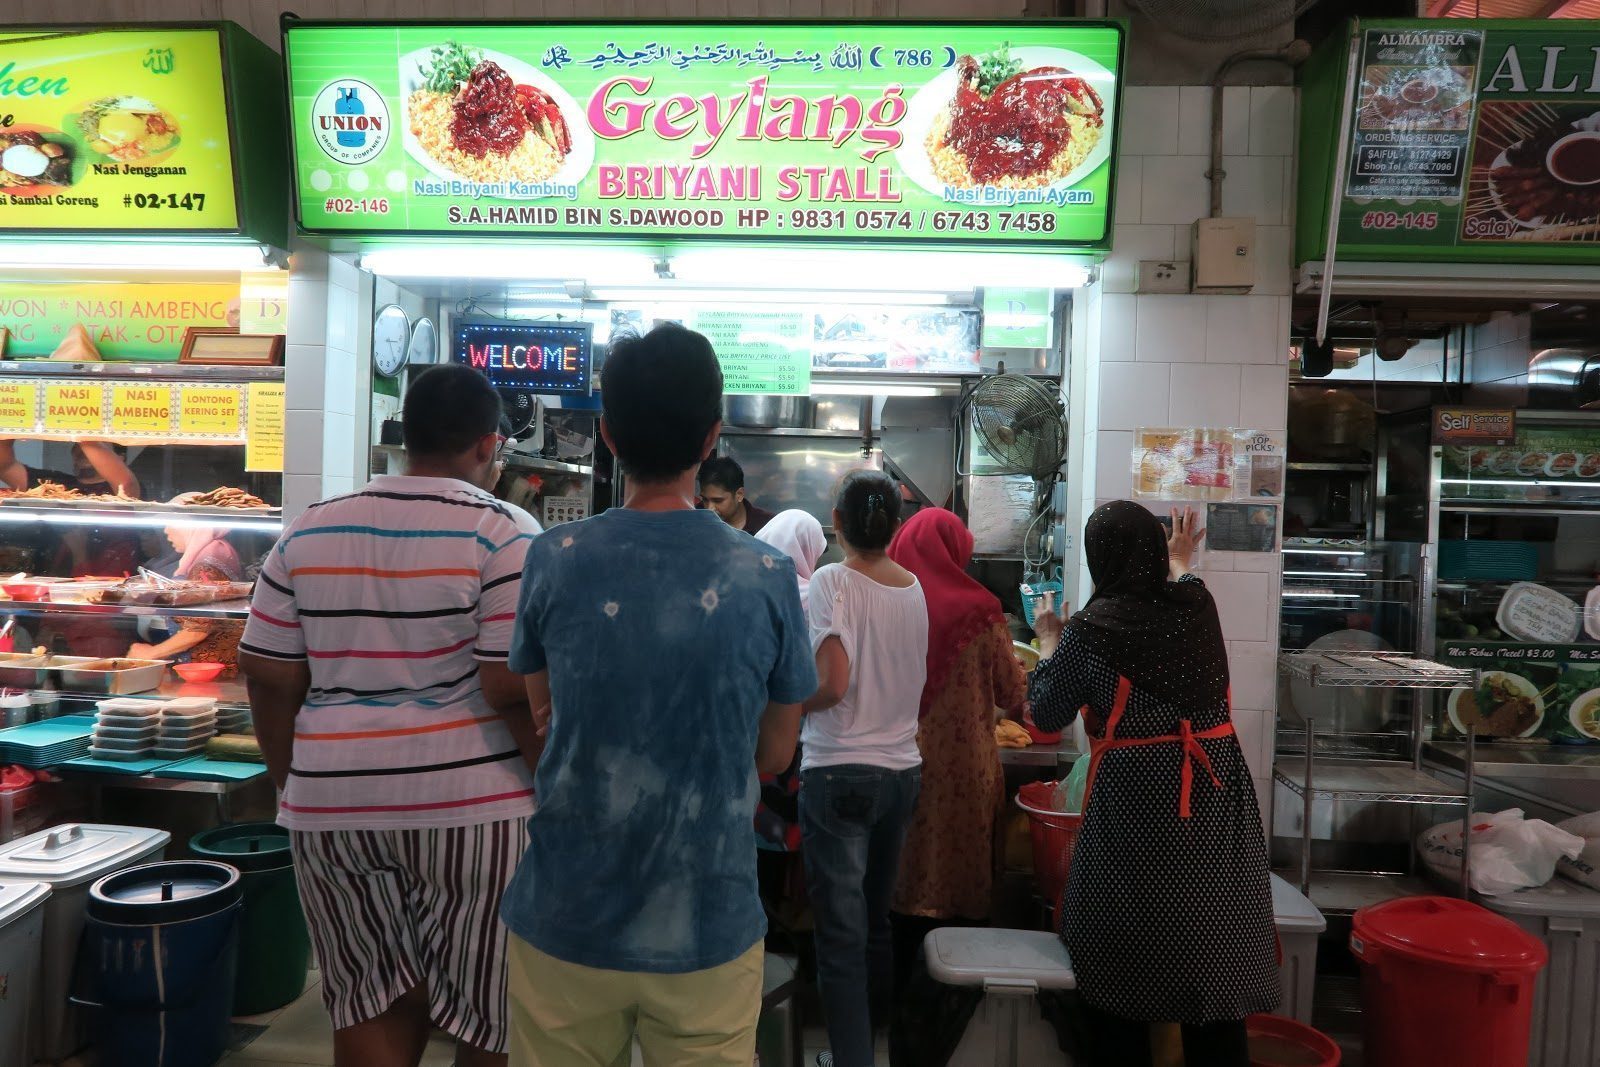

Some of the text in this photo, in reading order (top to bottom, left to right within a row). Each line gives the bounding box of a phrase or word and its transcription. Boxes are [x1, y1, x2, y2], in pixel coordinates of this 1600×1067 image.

[1378, 34, 1466, 46] ALMAMBRA
[319, 115, 383, 131] UNION
[587, 75, 907, 163] Geylang
[1365, 133, 1456, 142] ORDERING SERVICE
[322, 134, 339, 152] GROUP
[353, 135, 382, 159] COMPANIES
[1368, 150, 1399, 159] SAIFUL
[93, 164, 187, 177] Nasi Jengganan
[1364, 162, 1386, 171] Shop
[414, 180, 577, 199] Nasi Briyani Kambing
[598, 164, 903, 203] BRIYANI STALL
[10, 195, 52, 205] Sambal
[56, 195, 98, 208] Goreng
[123, 193, 205, 211] #02-147
[944, 186, 1092, 205] Nasi Briyani Ayam
[325, 198, 388, 213] #02-146
[449, 207, 558, 225] S.A.HAMID
[566, 208, 602, 226] BIN
[609, 208, 724, 227] S.DAWOOD
[738, 209, 769, 227] HP
[791, 210, 845, 228] 9831
[855, 211, 911, 230] 0574
[933, 211, 989, 231] 6743
[999, 212, 1056, 232] 7458
[1361, 212, 1438, 229] #02-145
[1465, 217, 1519, 238] Satay
[76, 301, 123, 318] NASI
[129, 301, 225, 320] AMBENG
[469, 344, 577, 371] WELCOME
[60, 389, 90, 399] NASI
[126, 390, 157, 401] NASI
[187, 395, 233, 405] LONTONG
[49, 406, 99, 417] RAWON
[114, 407, 169, 418] AMBENG
[184, 408, 235, 416] KERING SET
[1440, 413, 1471, 431] Self
[1473, 414, 1509, 423] Service
[1251, 436, 1270, 444] TOP
[1448, 647, 1466, 657] Mee
[1468, 647, 1493, 657] Rebus
[1527, 649, 1555, 658] $3.00
[1569, 649, 1588, 659] Mee
